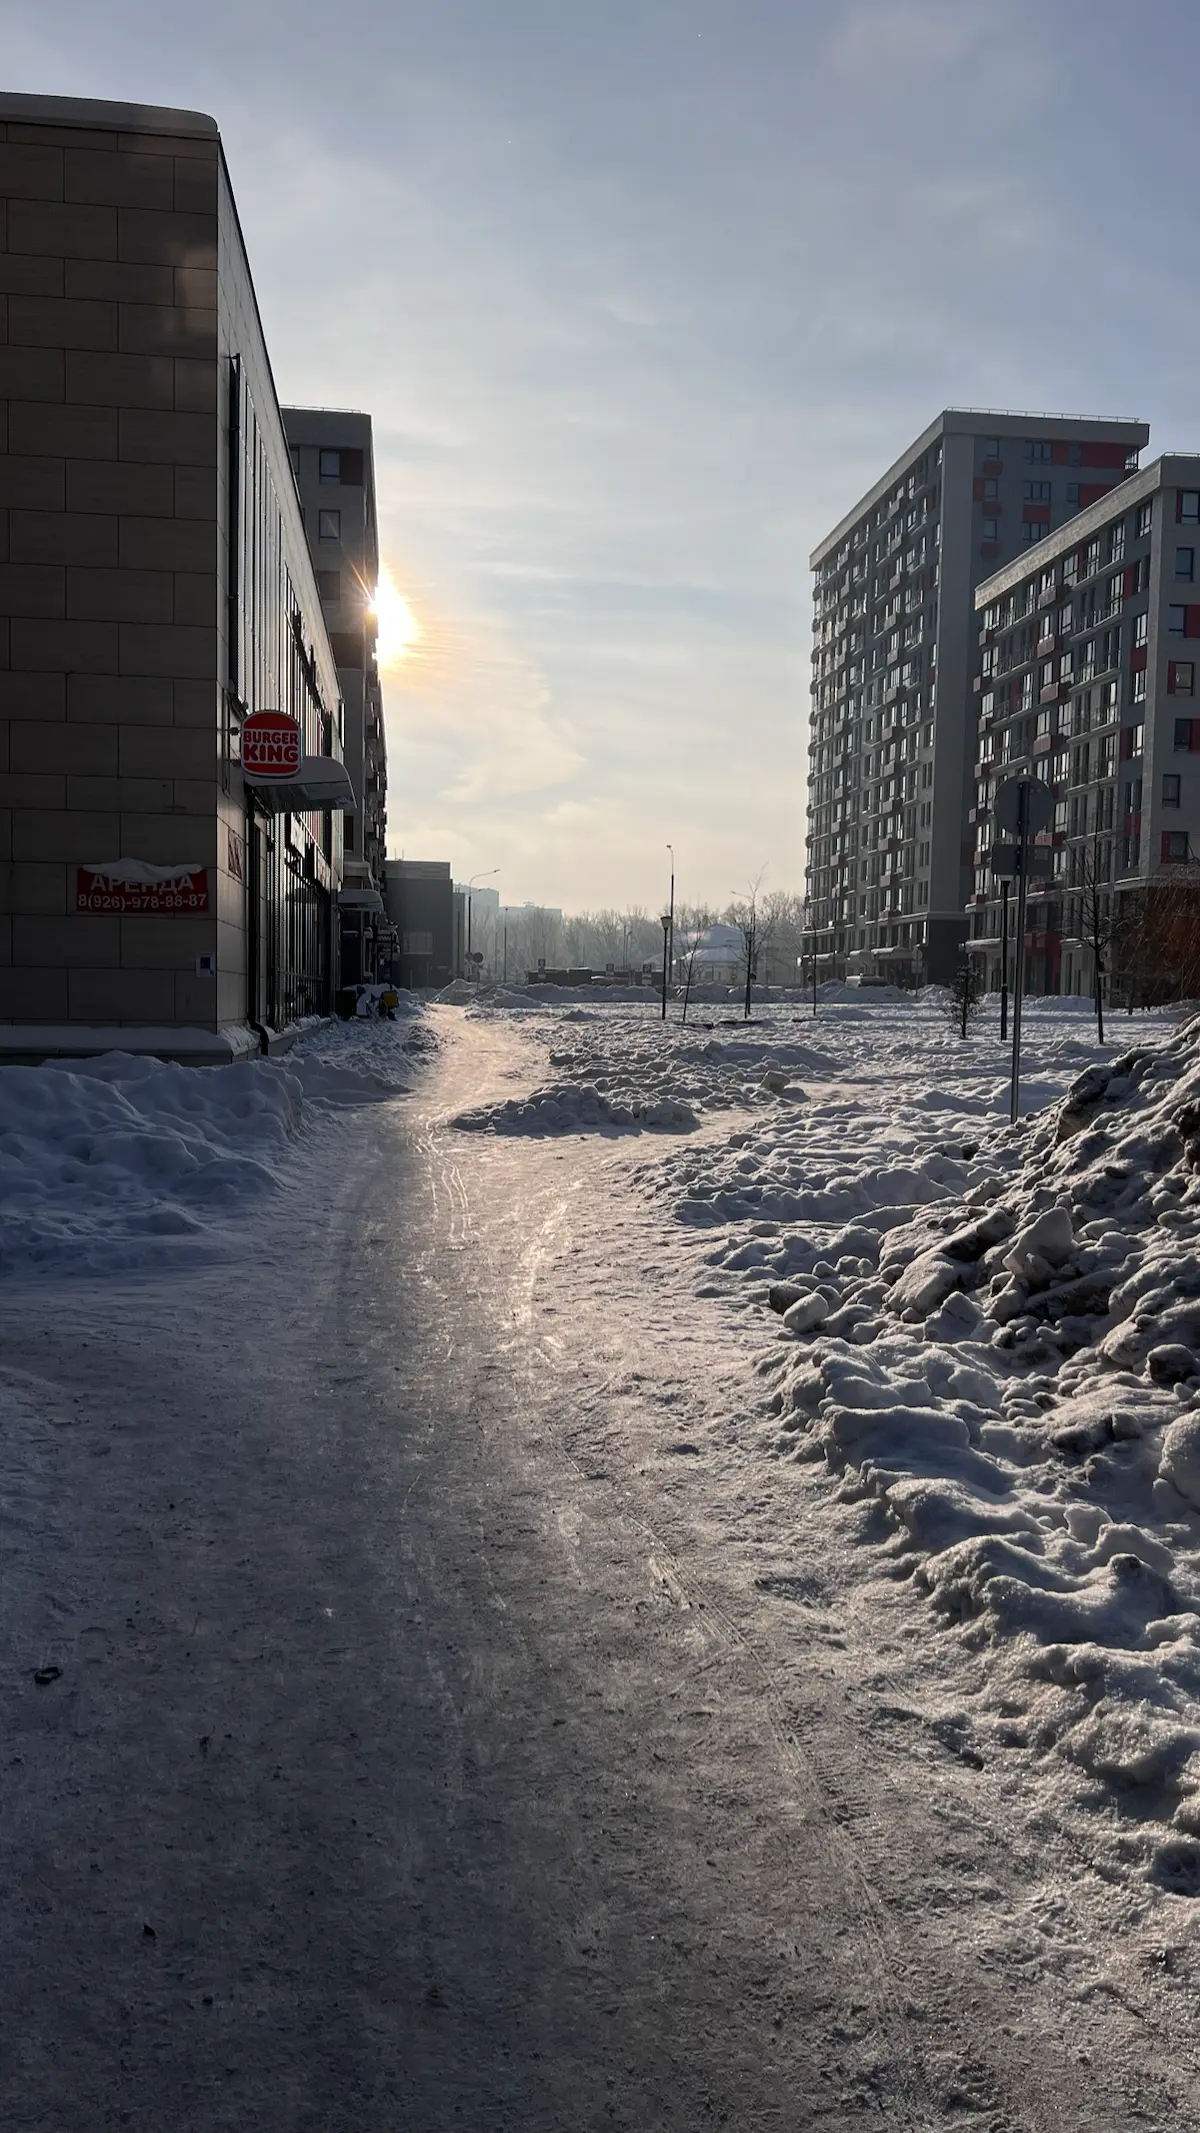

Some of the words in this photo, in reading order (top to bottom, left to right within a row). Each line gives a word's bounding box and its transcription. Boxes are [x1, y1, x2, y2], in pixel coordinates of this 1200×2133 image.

[243, 731, 298, 745] BURGER
[243, 744, 298, 763] KING
[78, 893, 207, 911] 8(926)-978-88-87
